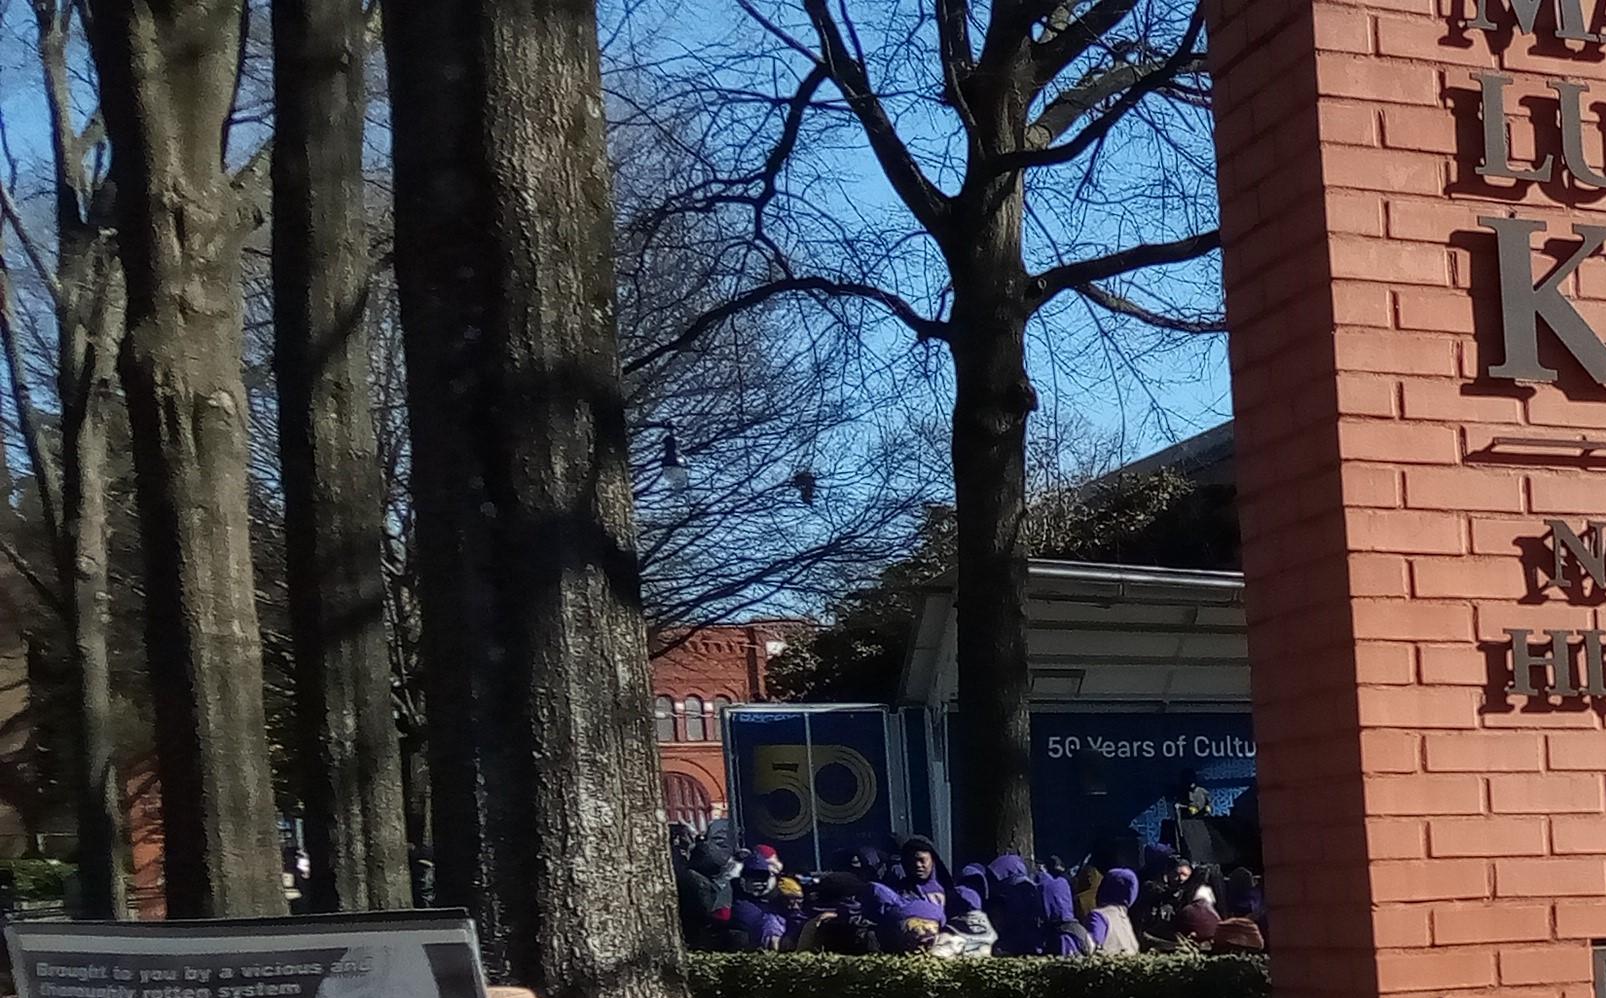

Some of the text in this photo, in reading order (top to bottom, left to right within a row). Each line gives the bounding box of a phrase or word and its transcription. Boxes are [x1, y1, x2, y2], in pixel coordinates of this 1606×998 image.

[1087, 736, 1155, 757] Years
[1163, 736, 1186, 757] of
[36, 962, 108, 981] Brought
[139, 967, 177, 983] you
[184, 965, 210, 983] by
[218, 966, 233, 979] a
[241, 961, 322, 978] vicious
